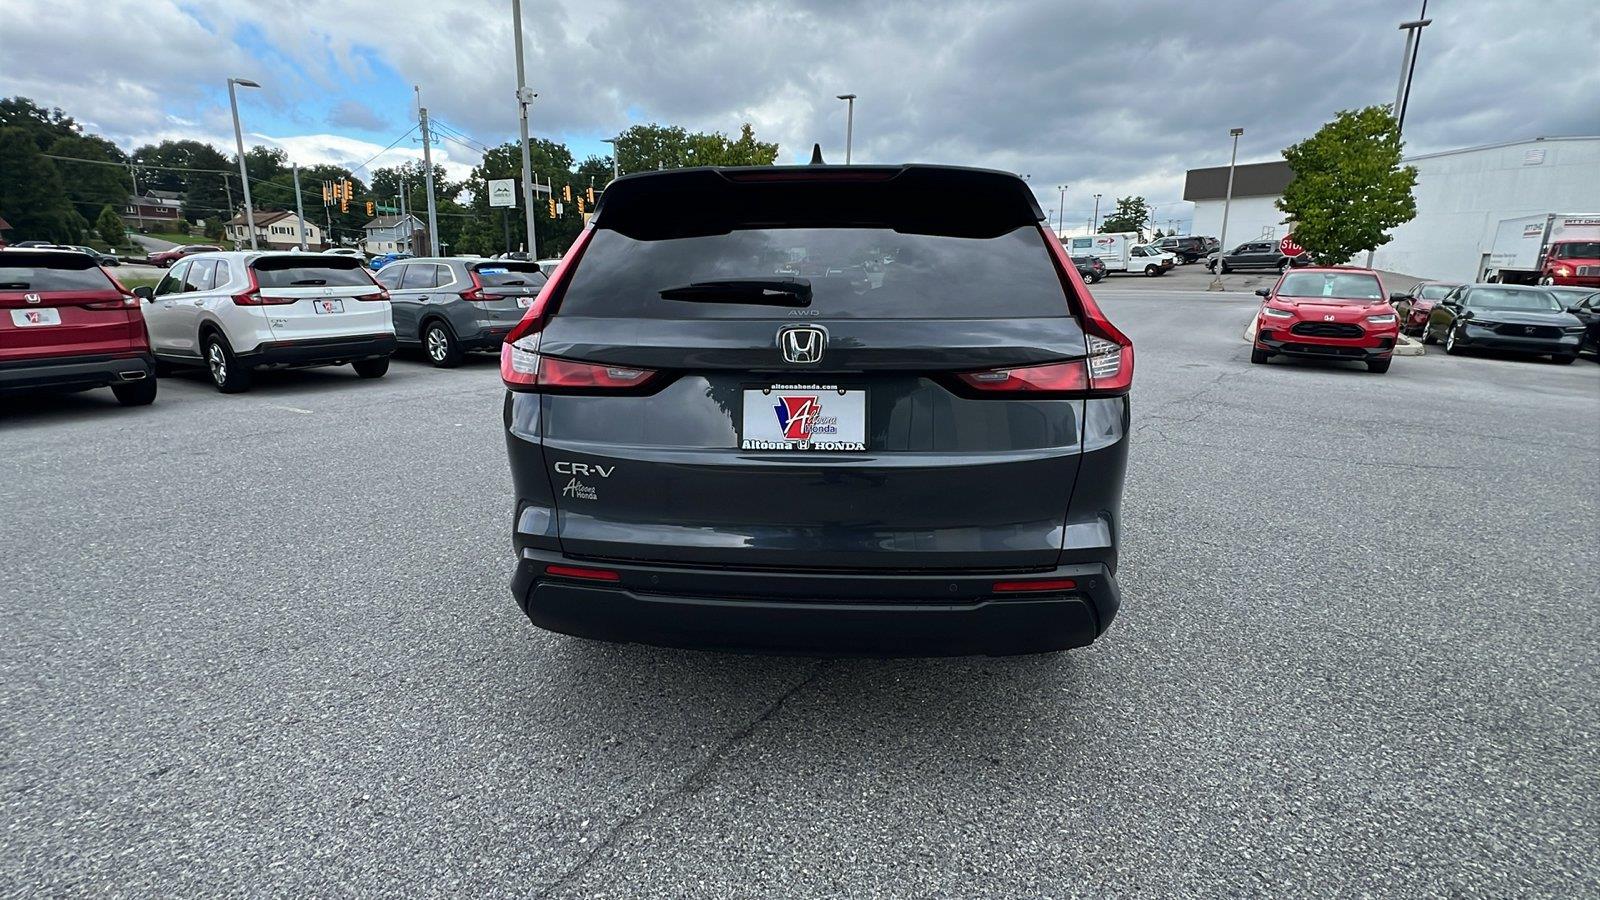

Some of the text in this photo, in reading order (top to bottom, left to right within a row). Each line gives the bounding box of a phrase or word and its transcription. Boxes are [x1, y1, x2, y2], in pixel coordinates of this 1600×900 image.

[1281, 239, 1303, 250] STO
[804, 424, 838, 434] Honda
[741, 439, 793, 450] Altoona
[814, 441, 866, 451] HONDA
[554, 461, 616, 478] CR-V
